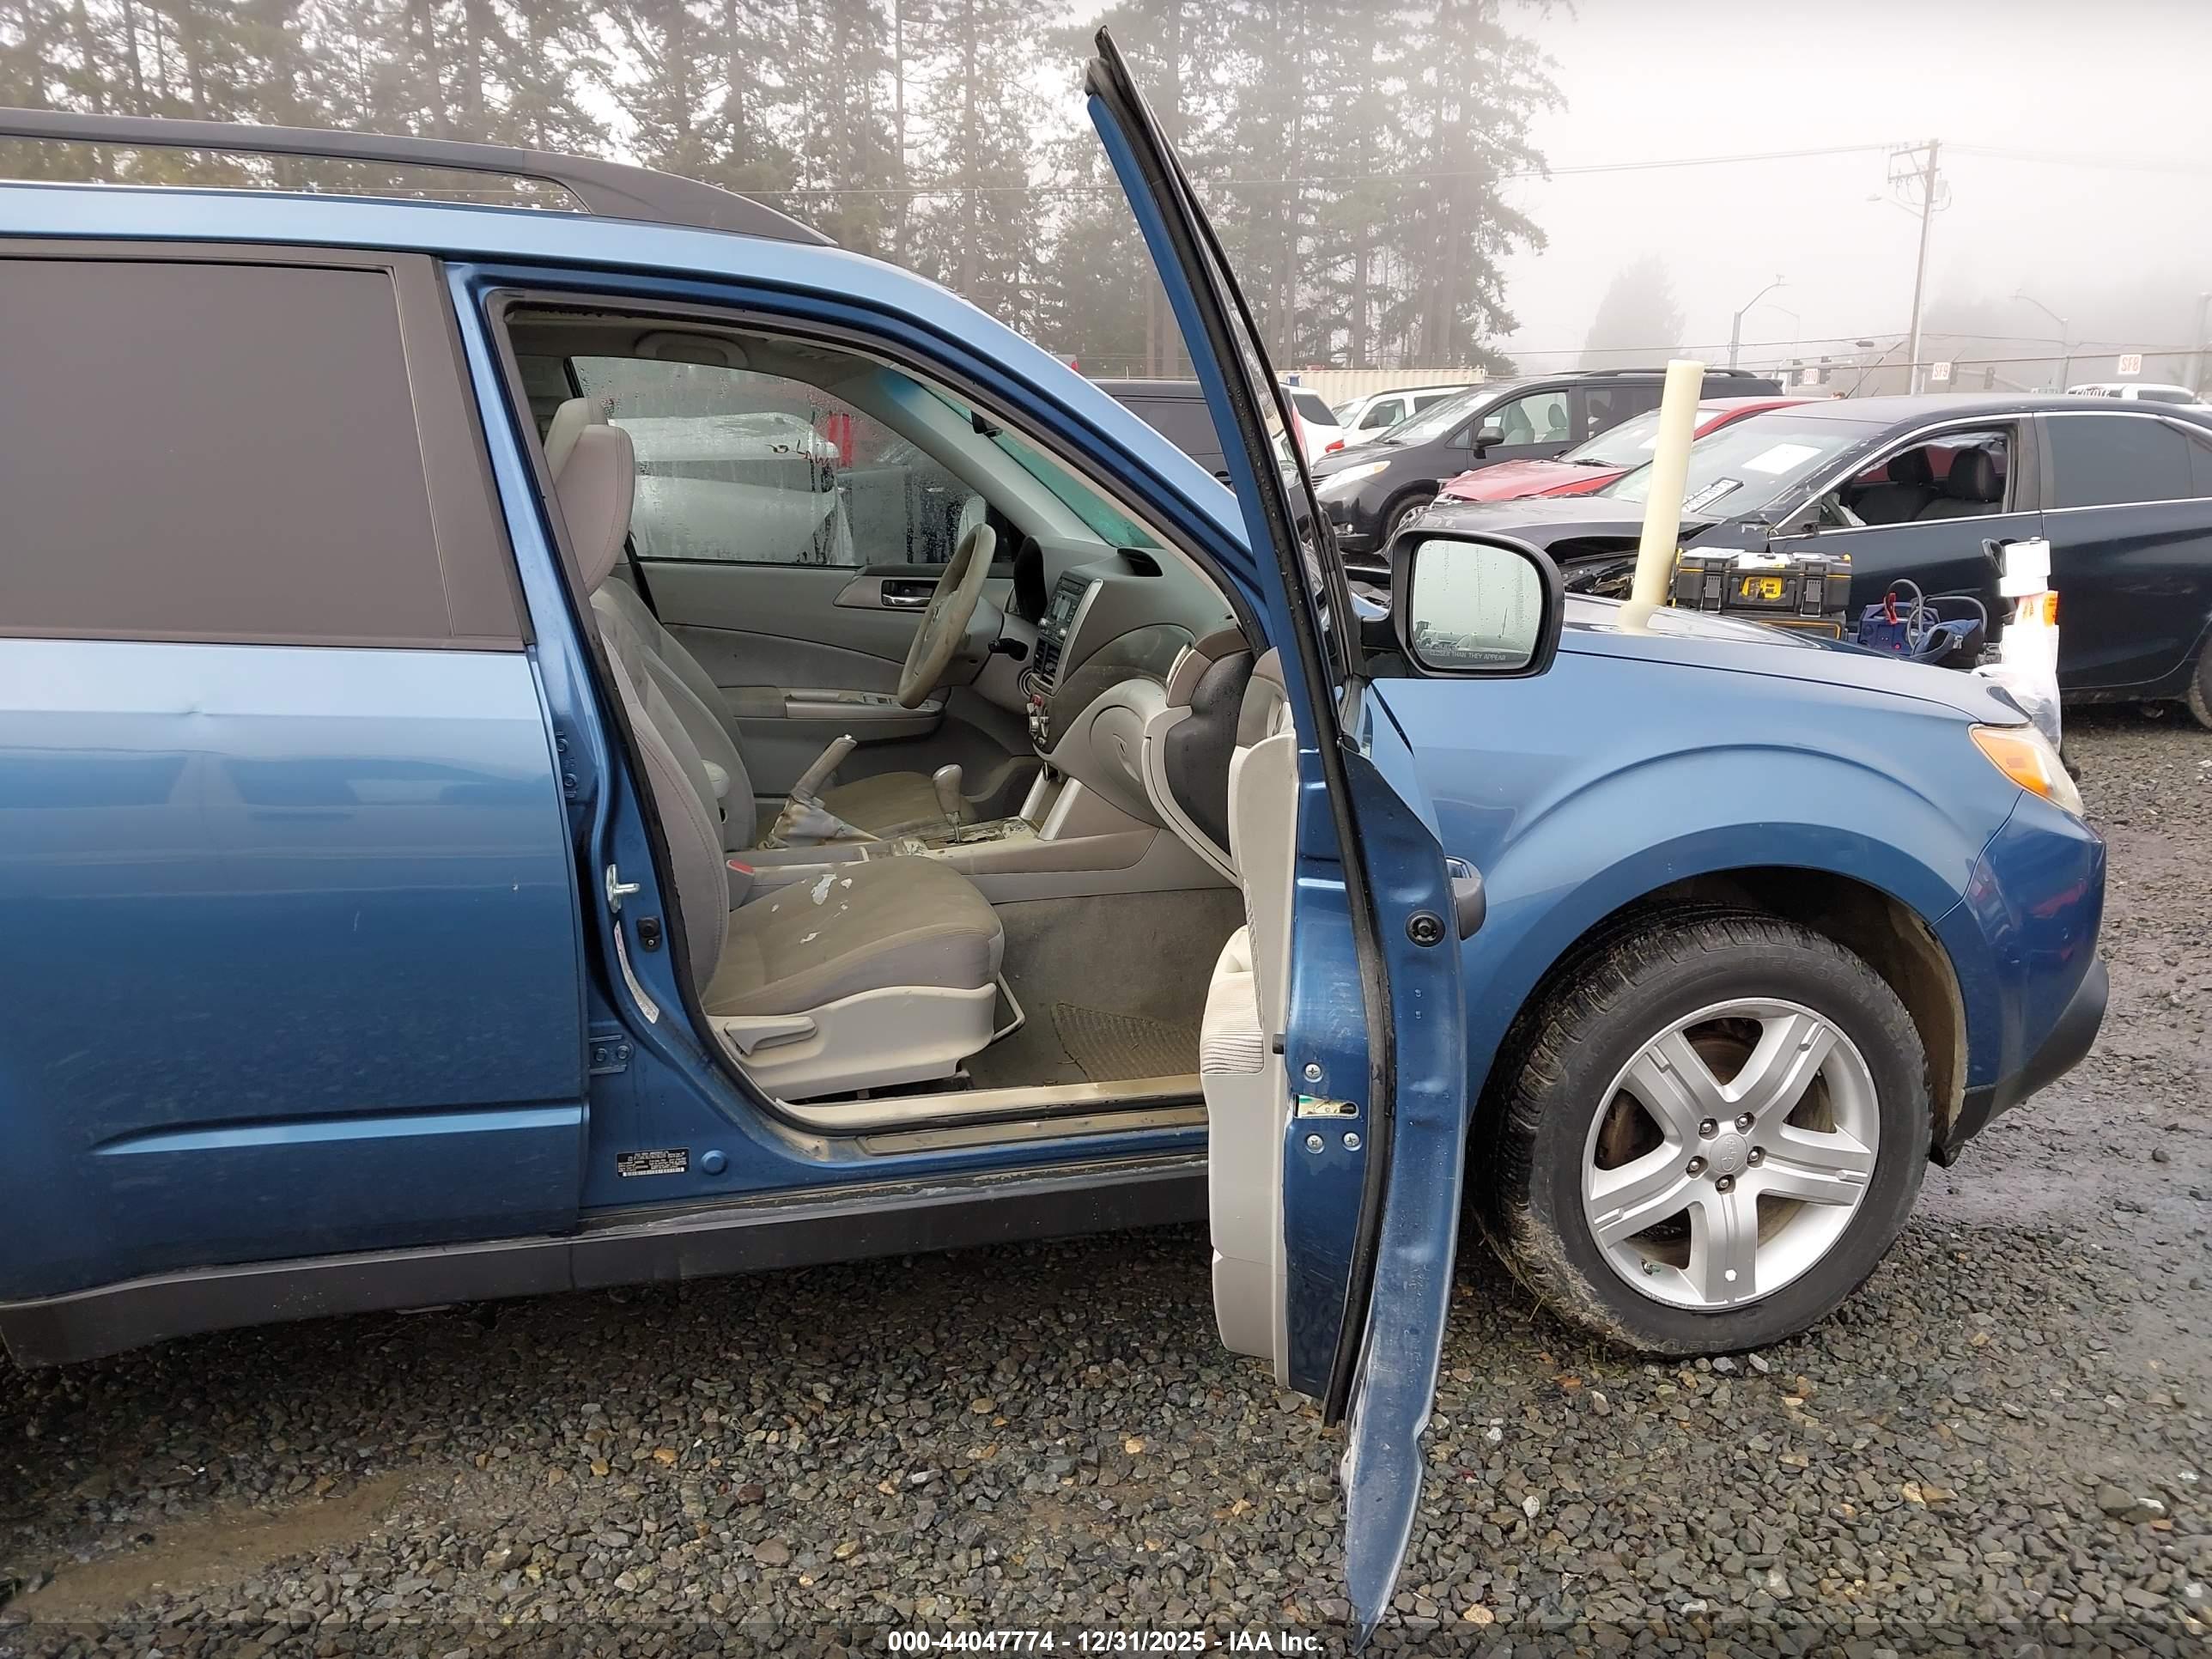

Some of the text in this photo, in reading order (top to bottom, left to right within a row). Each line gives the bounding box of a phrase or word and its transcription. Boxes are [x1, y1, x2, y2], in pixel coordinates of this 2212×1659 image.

[1934, 363, 1948, 378] SF9
[2121, 356, 2139, 372] SF8
[1804, 369, 1818, 384] SF10
